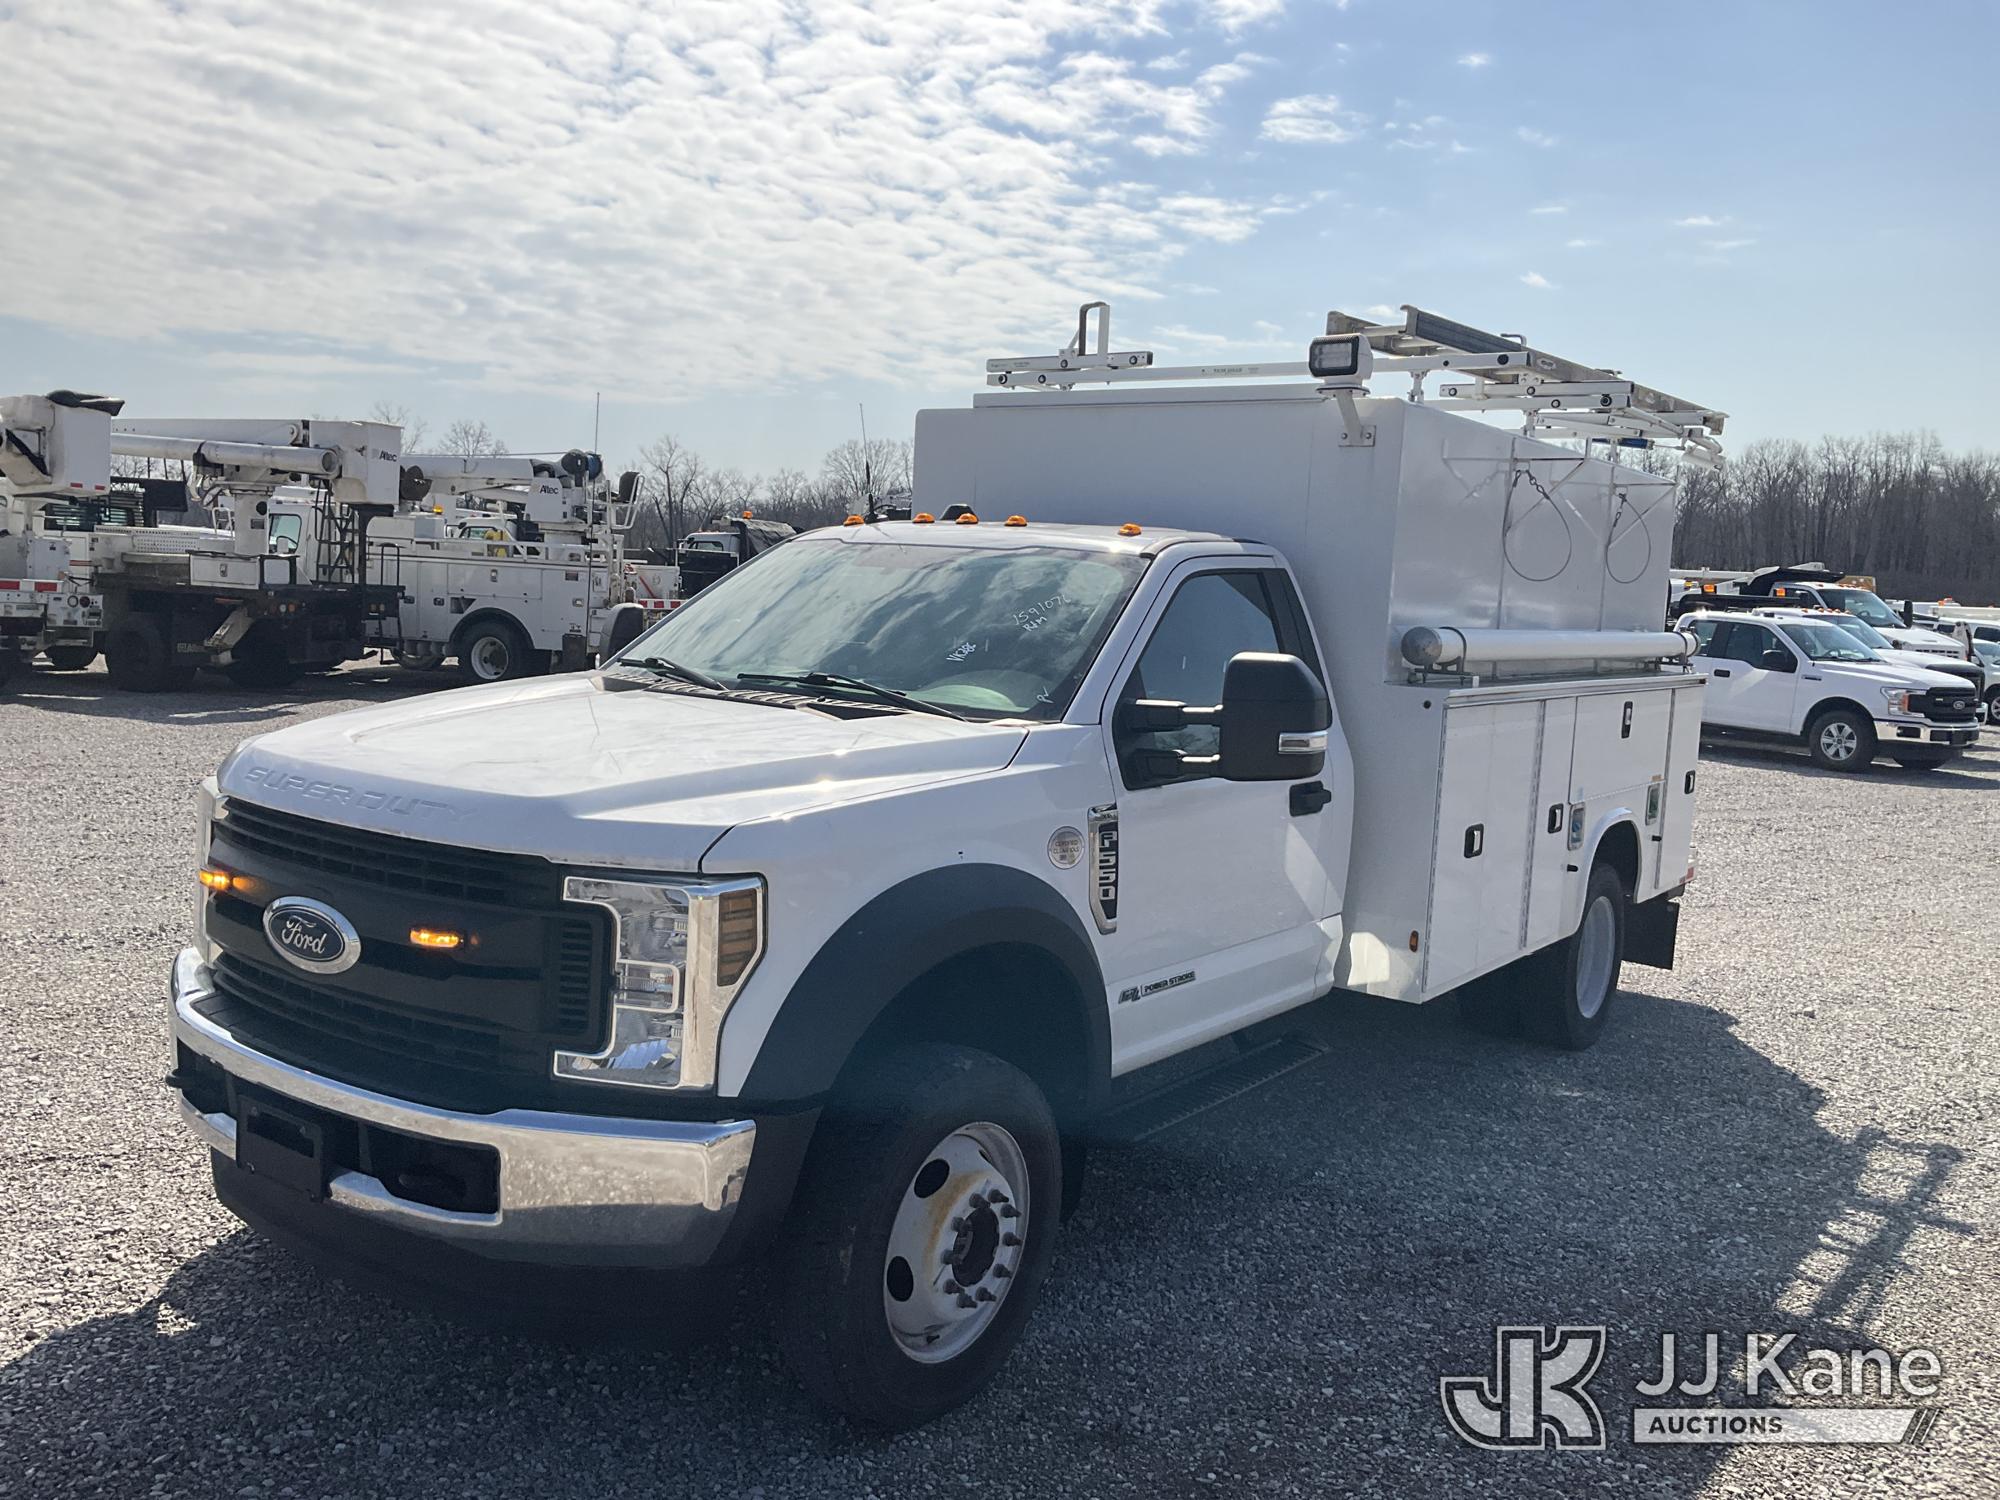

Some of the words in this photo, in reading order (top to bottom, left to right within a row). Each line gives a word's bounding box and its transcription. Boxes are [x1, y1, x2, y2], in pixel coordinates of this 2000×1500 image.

[379, 450, 398, 462] Altec
[539, 484, 559, 495] Altec
[245, 766, 354, 806] SUPER
[356, 790, 480, 821] DUTY
[282, 915, 328, 954] Ford
